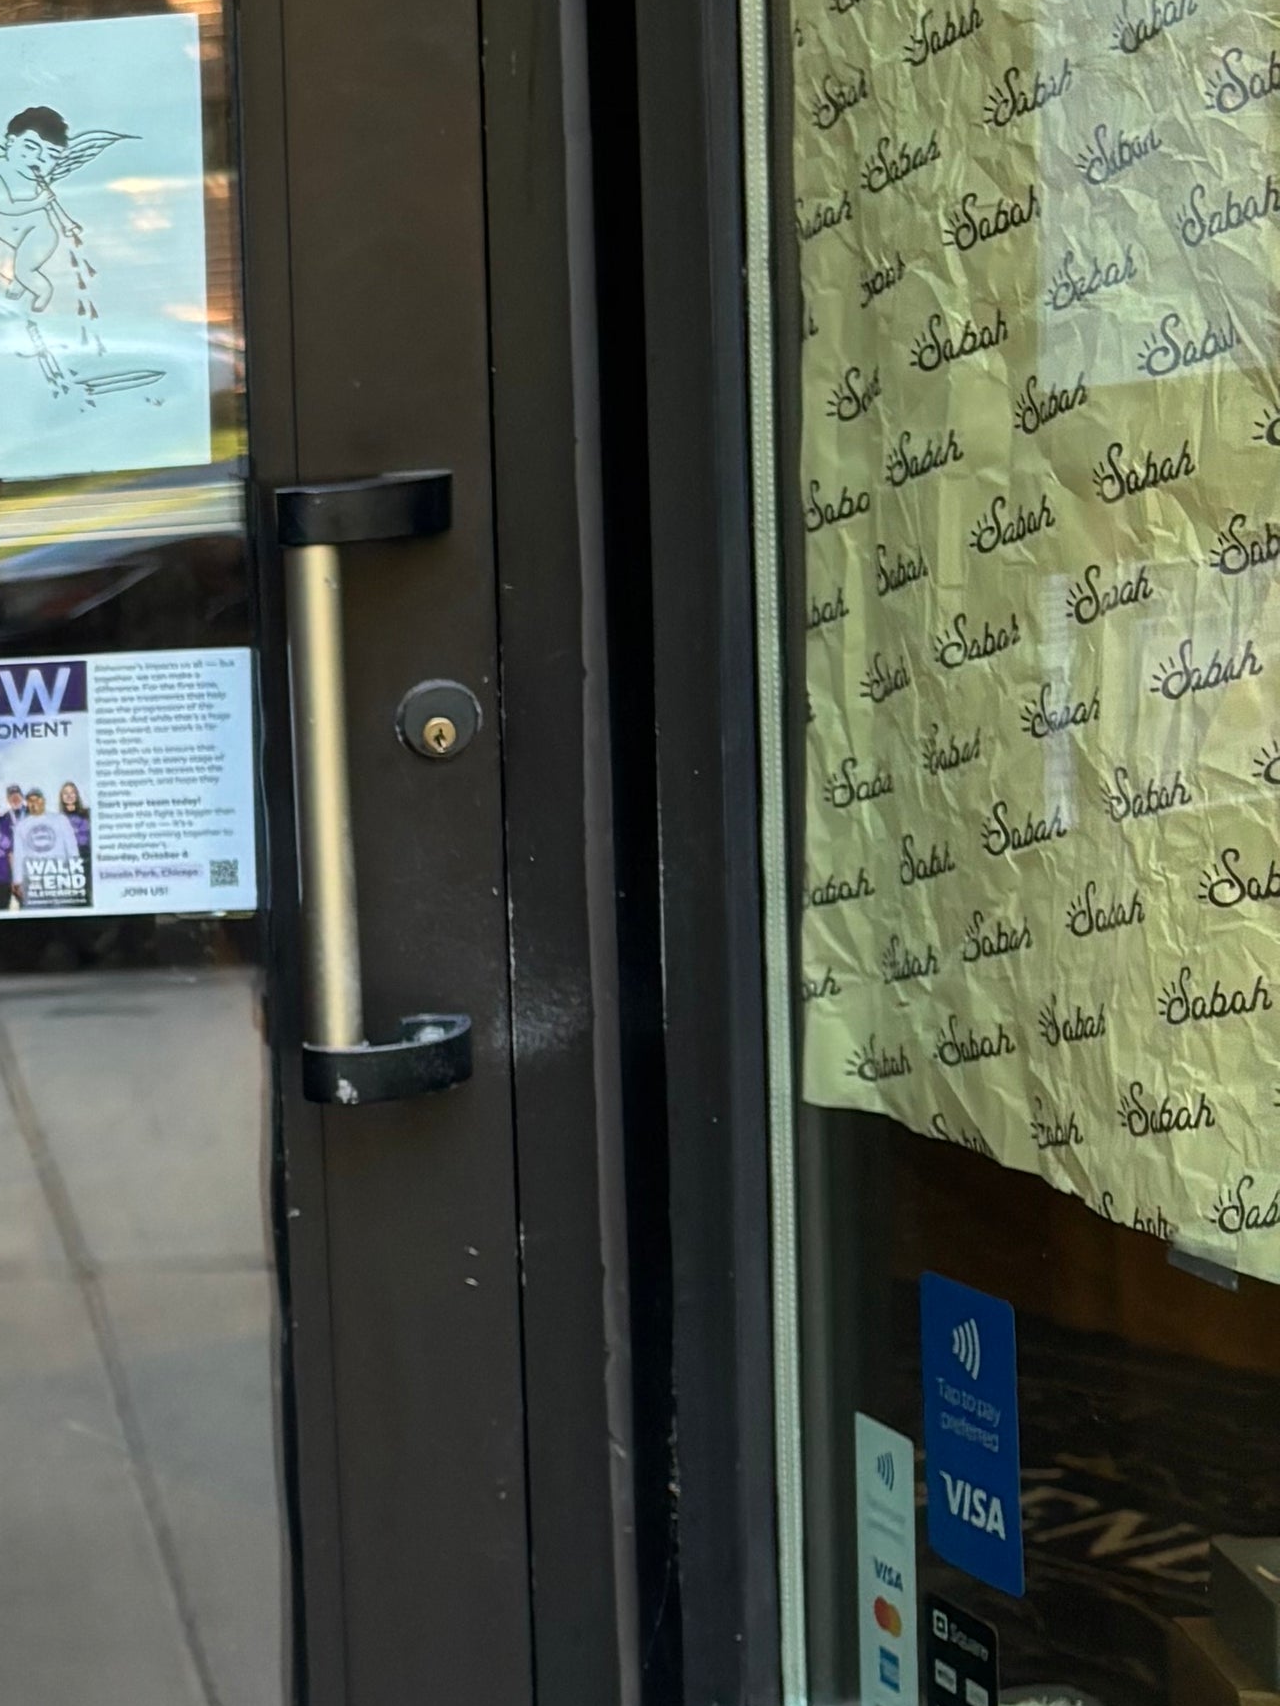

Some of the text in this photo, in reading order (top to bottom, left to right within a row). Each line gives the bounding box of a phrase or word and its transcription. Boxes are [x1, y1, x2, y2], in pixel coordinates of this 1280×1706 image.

[867, 130, 940, 193] Sabah
[954, 184, 1042, 250] Sabah
[1052, 244, 1137, 311] Sabah
[918, 309, 1009, 371] Sabah
[1021, 372, 1088, 434] Sabah
[888, 429, 964, 486] Sabah
[1100, 440, 1195, 504] Sabah
[976, 494, 1056, 553] Sabah
[940, 613, 1021, 669] Sabah
[1161, 639, 1263, 700] Sabah
[1109, 766, 1192, 823] Sabah
[987, 800, 1068, 856] Sabah
[25, 857, 85, 874] WALK
[43, 873, 86, 890] END
[811, 867, 875, 906] abah
[1165, 967, 1274, 1025] Sabah
[939, 1014, 1017, 1067] Sabah
[936, 1377, 961, 1407] Tap
[977, 1399, 1001, 1428] pay
[939, 1469, 1007, 1541] VISA
[872, 1555, 904, 1592] VISA
